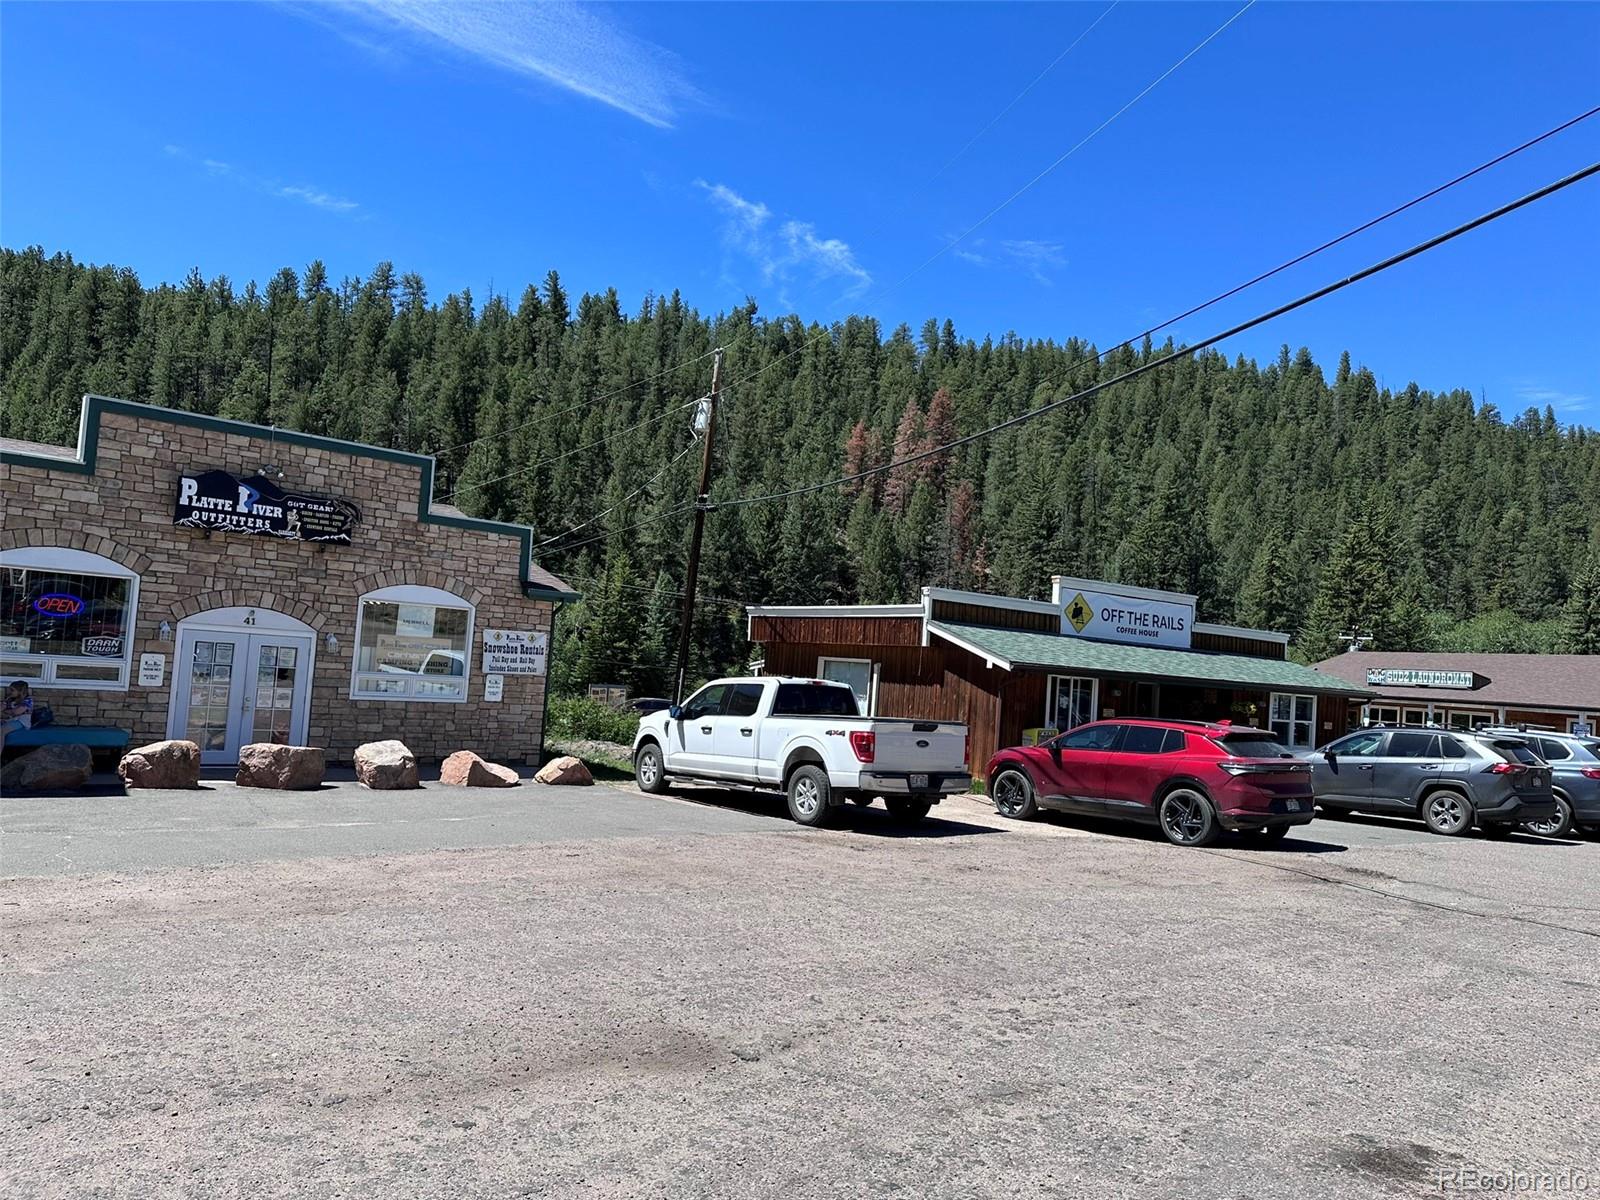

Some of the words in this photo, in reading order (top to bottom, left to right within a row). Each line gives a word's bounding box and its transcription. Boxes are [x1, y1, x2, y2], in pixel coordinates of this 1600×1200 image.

[179, 477, 233, 512] PLATTE
[236, 485, 283, 519] RIVER
[191, 510, 271, 529] OUTFITTERS
[37, 597, 80, 614] OPEN
[243, 617, 256, 626] 41
[1101, 607, 1125, 623] OFF
[1126, 611, 1149, 628] THE
[1152, 614, 1185, 632] RAILS
[1116, 626, 1137, 635] COFFEE
[1139, 629, 1159, 638] HOUSE
[86, 645, 119, 653] TOUGH
[87, 639, 120, 647] DARN
[484, 641, 519, 655] Snowshoe
[520, 643, 545, 656] Rentals
[1411, 670, 1473, 686] LAUNDROMAT
